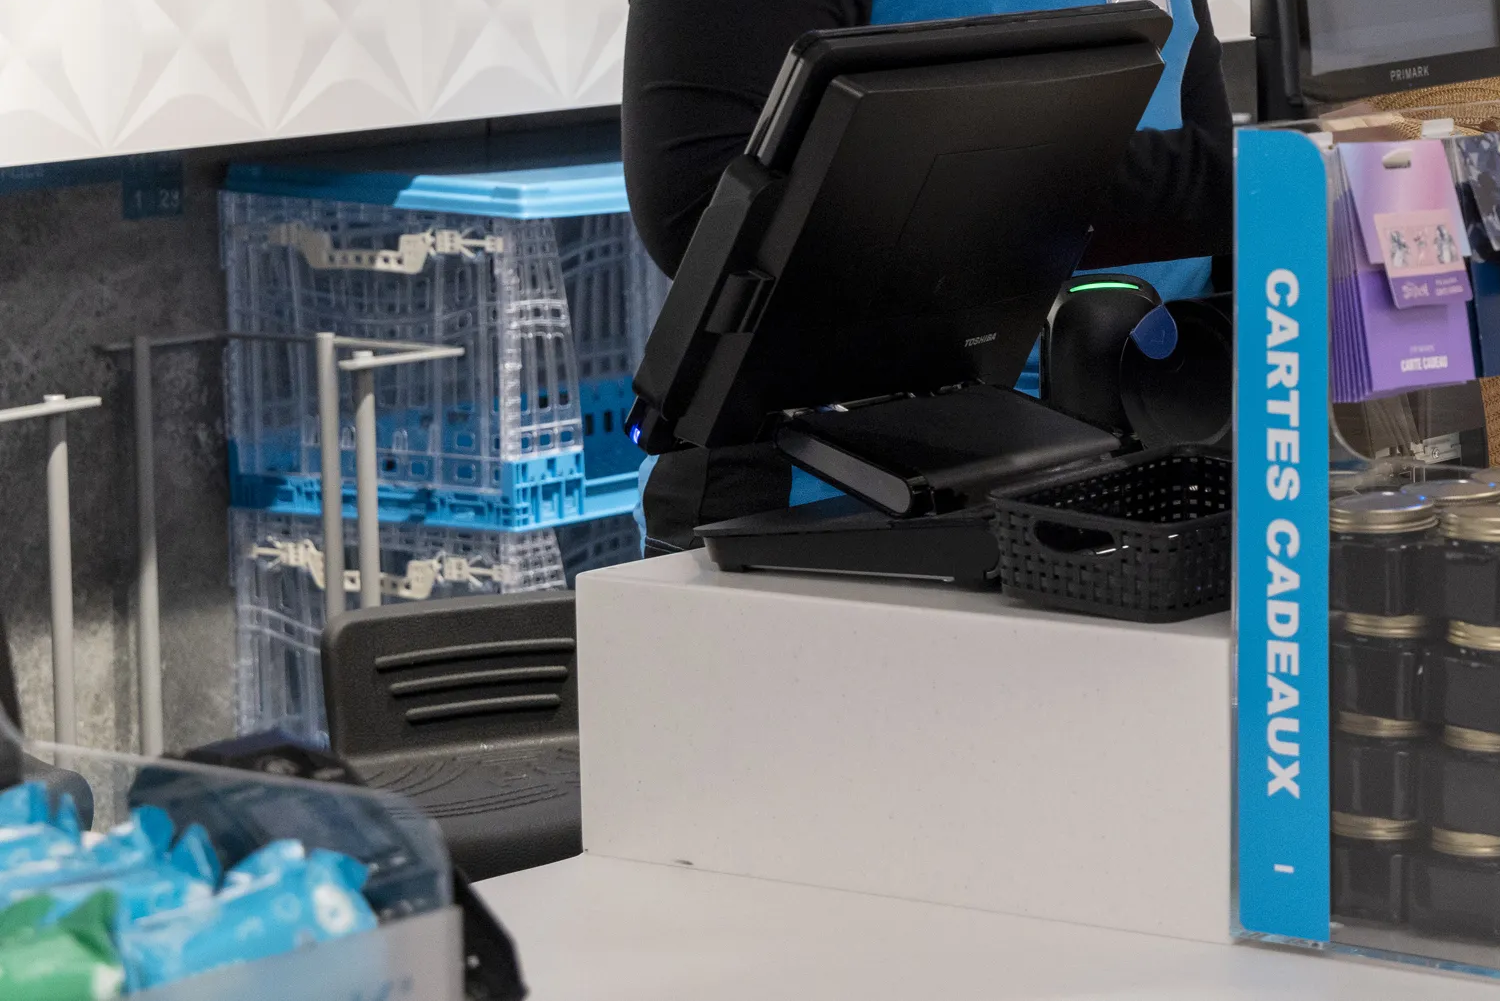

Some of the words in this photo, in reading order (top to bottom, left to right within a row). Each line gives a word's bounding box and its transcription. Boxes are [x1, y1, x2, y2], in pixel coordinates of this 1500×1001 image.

[1389, 64, 1430, 82] PRIMARK
[964, 332, 997, 348] TOSHIBA
[1265, 268, 1301, 501] CARTES
[1265, 518, 1301, 800] CADEAUX
